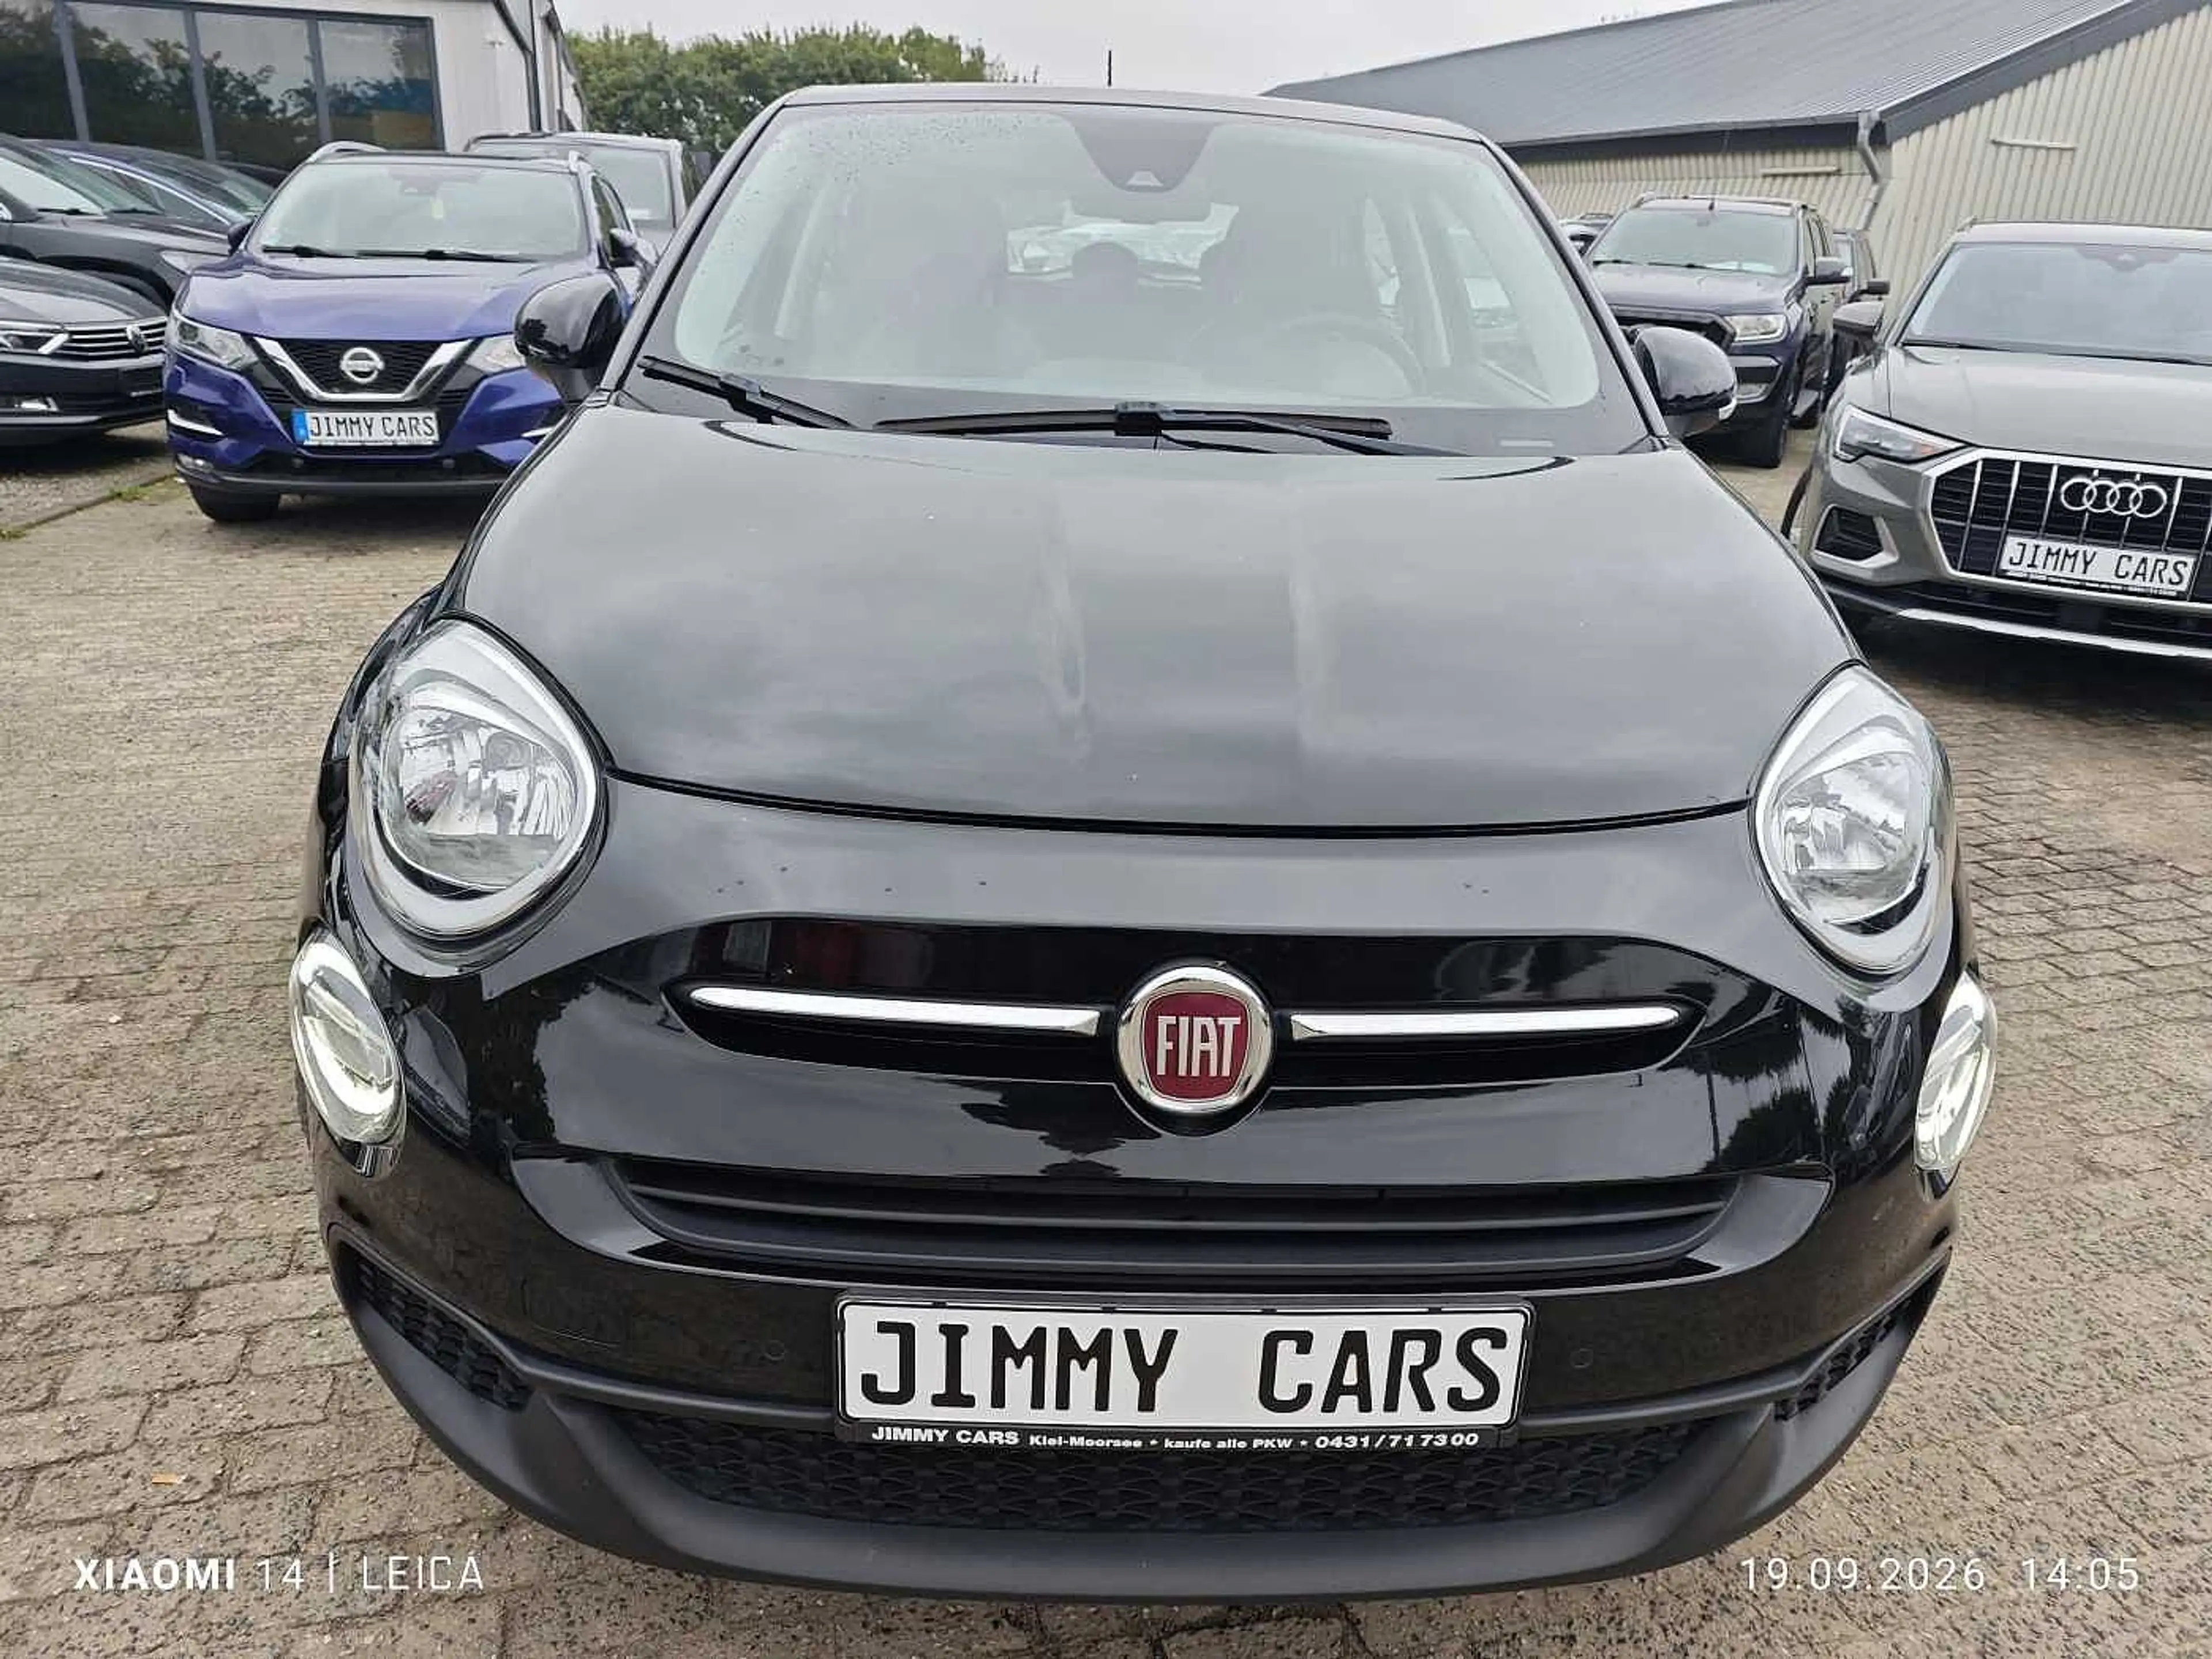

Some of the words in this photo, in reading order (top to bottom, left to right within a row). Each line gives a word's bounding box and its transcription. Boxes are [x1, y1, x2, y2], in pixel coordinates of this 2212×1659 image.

[311, 416, 374, 437] JIMMY
[382, 416, 435, 437] CARS
[2009, 541, 2097, 574] JIMMY
[2114, 554, 2188, 586] CARS
[1156, 1016, 1241, 1077] FIAT
[861, 1321, 1179, 1412] JIMMY
[1258, 1327, 1507, 1414] CARS
[872, 1426, 949, 1442] JIMMY
[955, 1430, 1019, 1445] CARS
[1164, 1438, 1211, 1448] kaufe
[1216, 1438, 1248, 1448] alle
[1252, 1438, 1293, 1448] PKW
